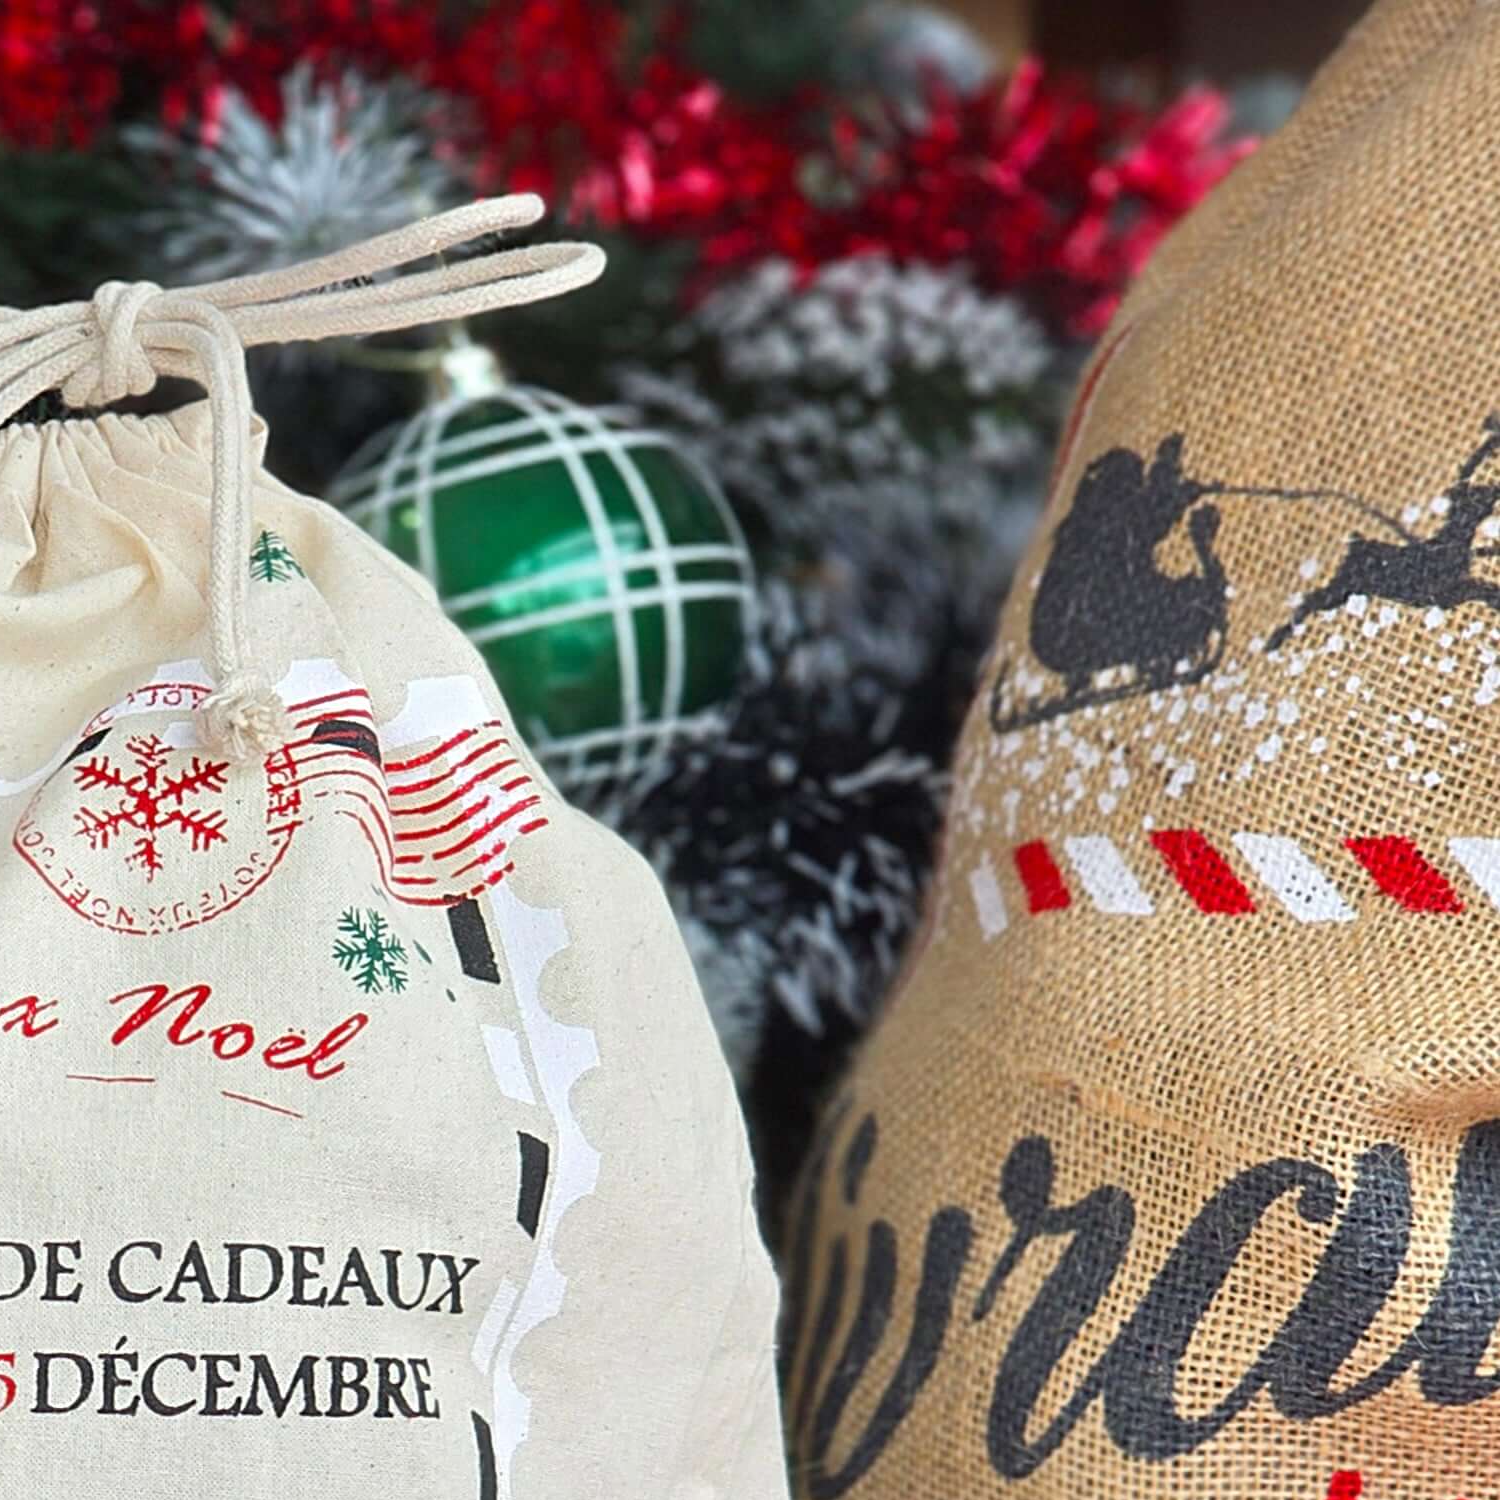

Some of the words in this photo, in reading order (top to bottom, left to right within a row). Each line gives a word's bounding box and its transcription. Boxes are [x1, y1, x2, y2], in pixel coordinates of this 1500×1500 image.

[108, 983, 369, 1081] Noël
[107, 1240, 481, 1315] CADEAUX
[30, 1335, 441, 1419] DÉCEMBRE
